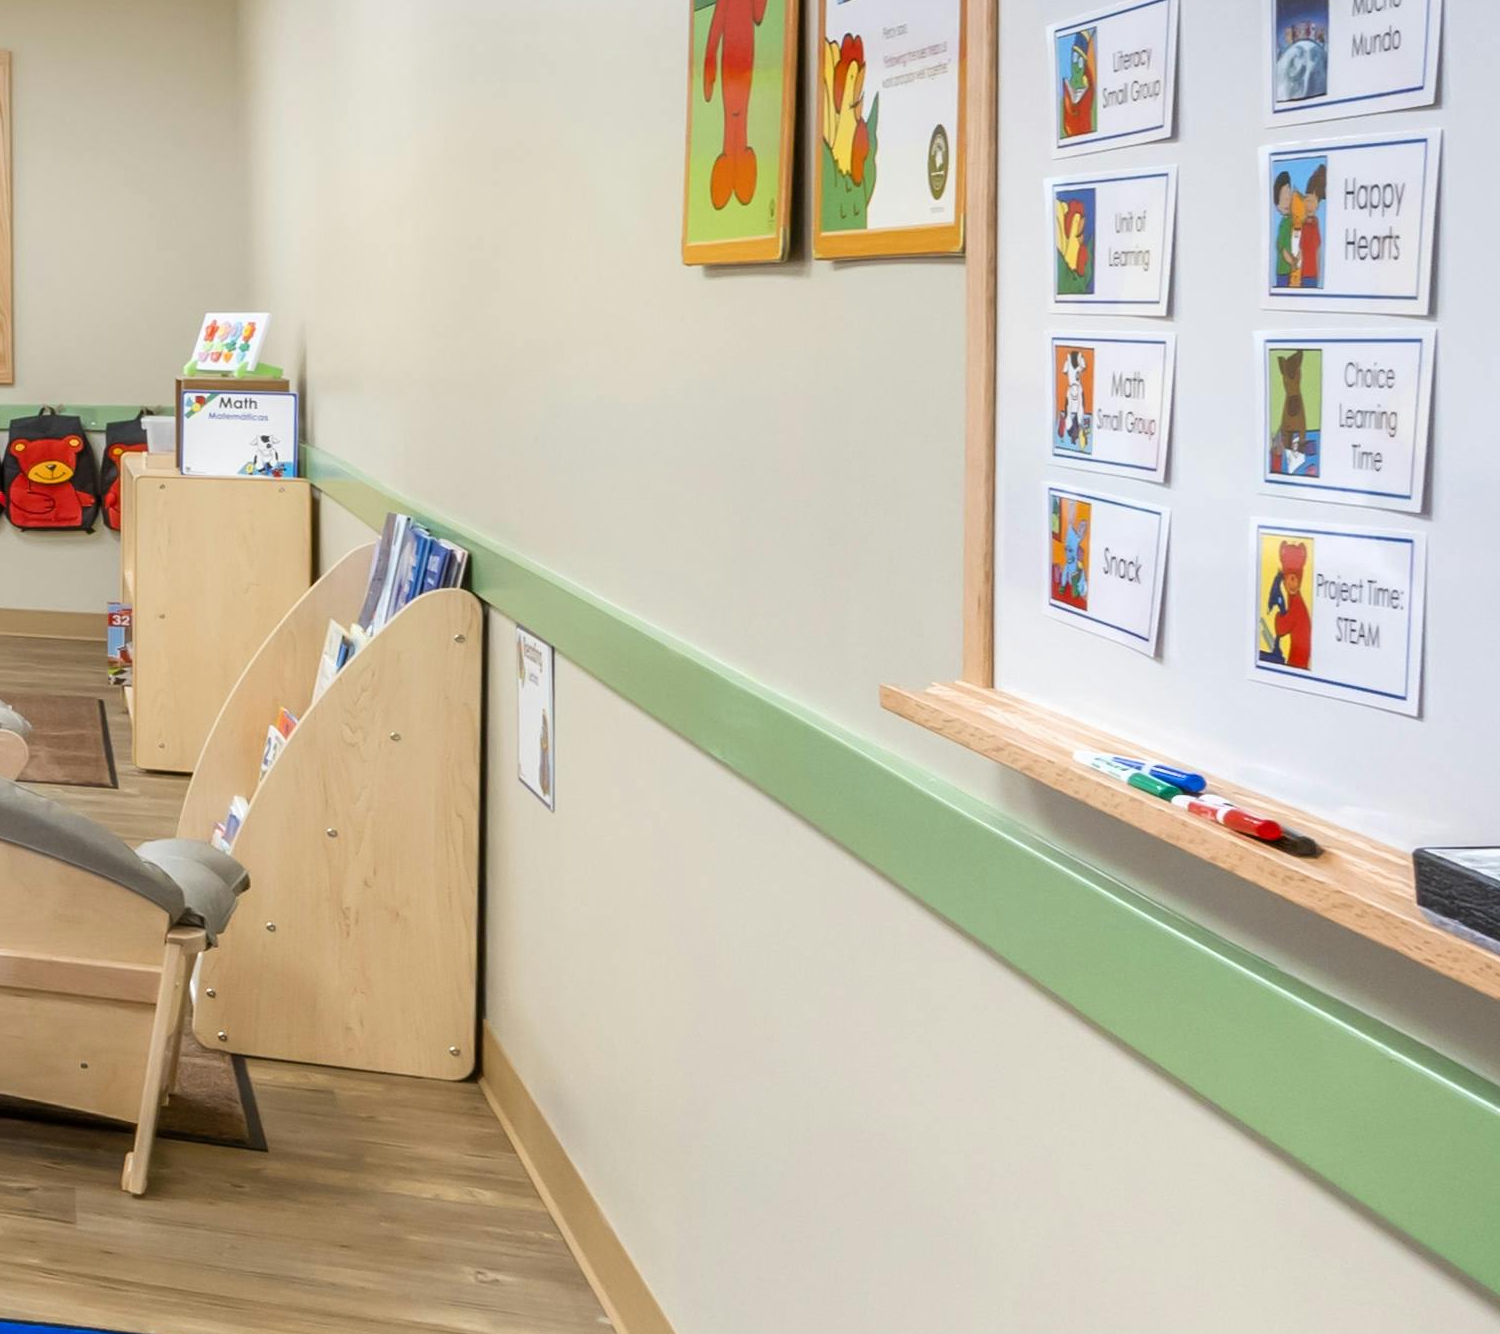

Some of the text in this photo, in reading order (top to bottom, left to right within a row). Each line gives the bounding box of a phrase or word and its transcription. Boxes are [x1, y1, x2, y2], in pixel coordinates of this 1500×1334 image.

[1351, 27, 1401, 59] Mundo
[1112, 47, 1153, 74] Literacy
[1102, 77, 1161, 110] Small Group
[1344, 177, 1406, 217] Happy
[1114, 210, 1147, 234] Unit of
[1108, 243, 1151, 273] Learning
[1344, 225, 1401, 262] Hearts
[1110, 370, 1145, 400] Math
[1344, 361, 1396, 390] Choice
[218, 397, 258, 409] Math
[1097, 408, 1157, 441] Small Group
[1338, 402, 1399, 439] Learning
[1351, 443, 1383, 473] Time
[1102, 547, 1143, 586] Snack
[1316, 573, 1405, 611] Project Time:
[111, 614, 130, 626] 32
[1335, 616, 1381, 649] STEAM
